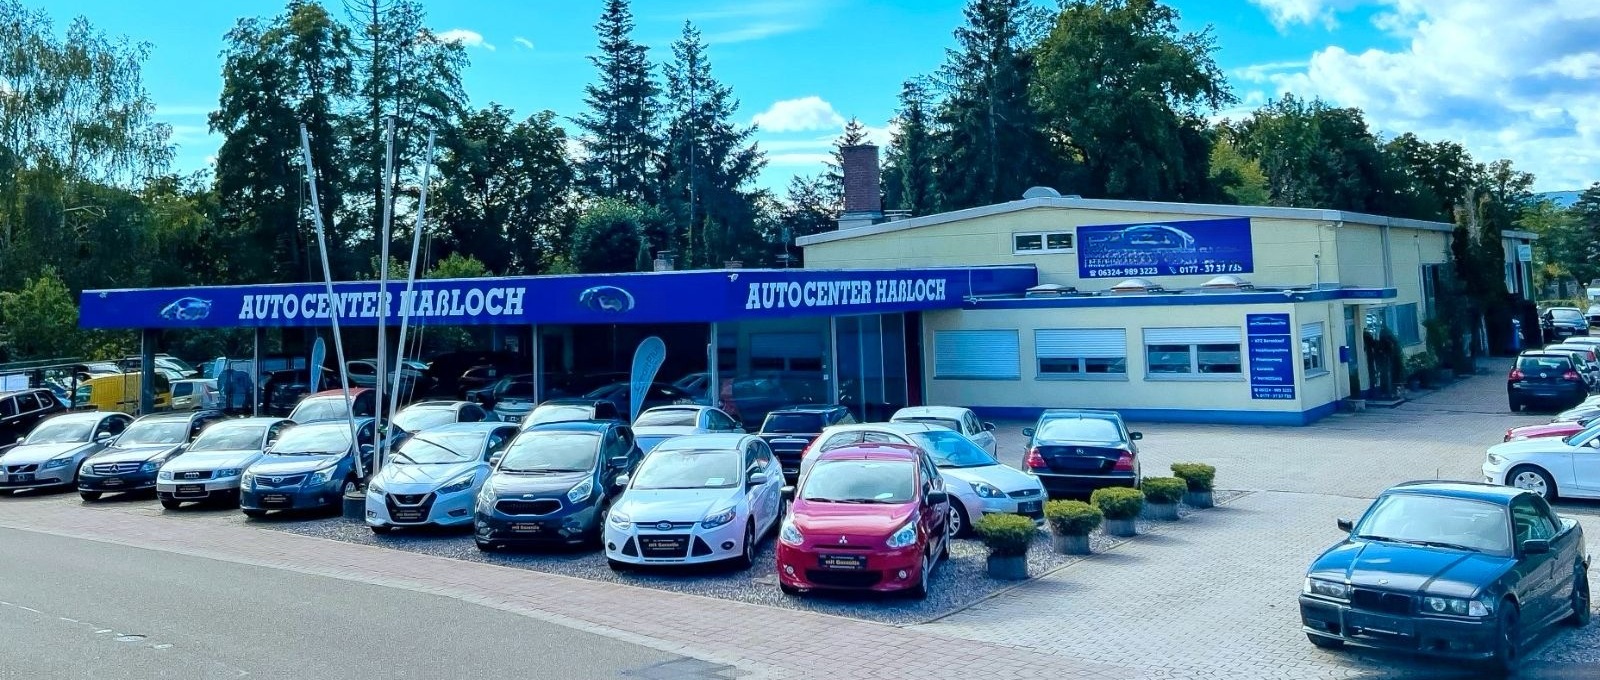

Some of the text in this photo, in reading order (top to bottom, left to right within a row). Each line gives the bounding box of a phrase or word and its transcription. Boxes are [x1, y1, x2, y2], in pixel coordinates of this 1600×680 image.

[1139, 267, 1158, 275] 3223
[1180, 265, 1198, 273] 0177
[875, 279, 946, 303] HAßLOCH
